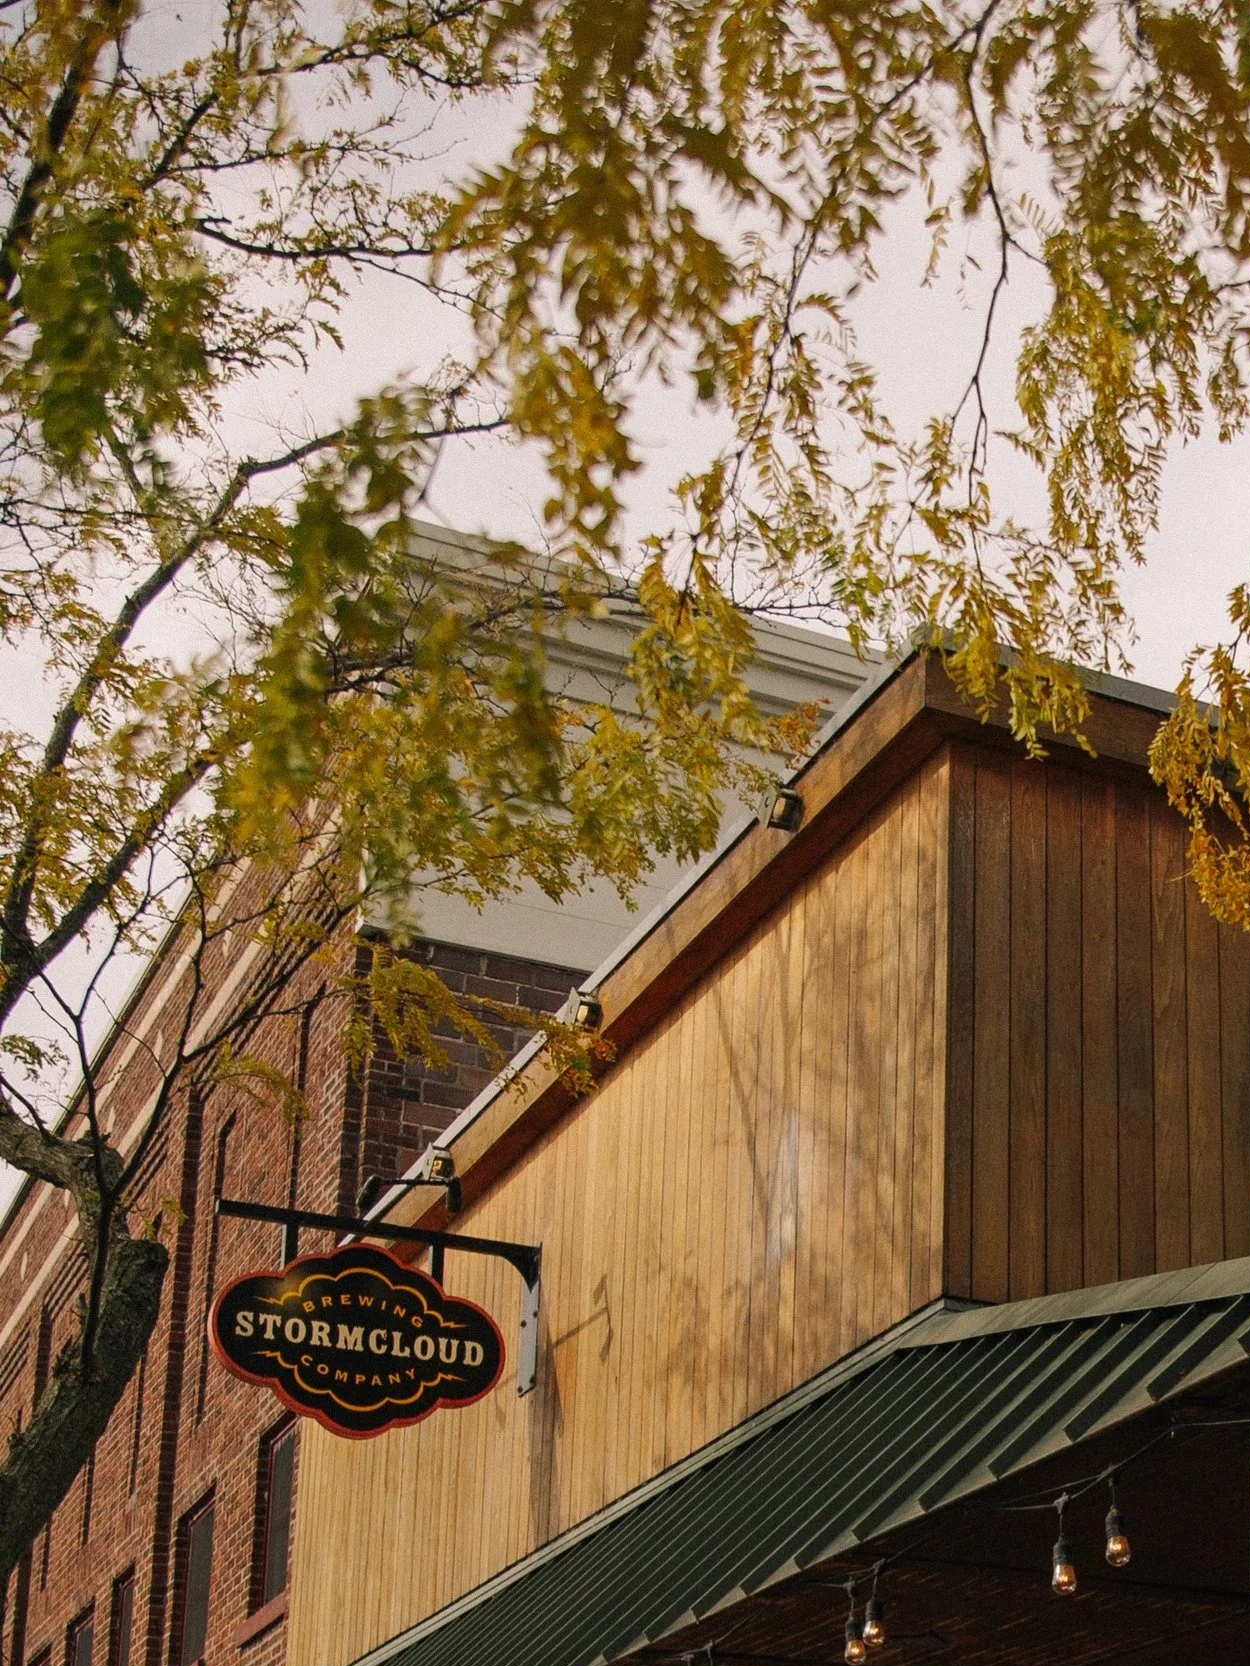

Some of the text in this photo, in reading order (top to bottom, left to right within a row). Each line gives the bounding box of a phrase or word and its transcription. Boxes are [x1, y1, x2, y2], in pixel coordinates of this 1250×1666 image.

[303, 1293, 424, 1329] BREWING
[234, 1311, 484, 1367] STORMCLOUD
[300, 1354, 417, 1387] COMPANY
